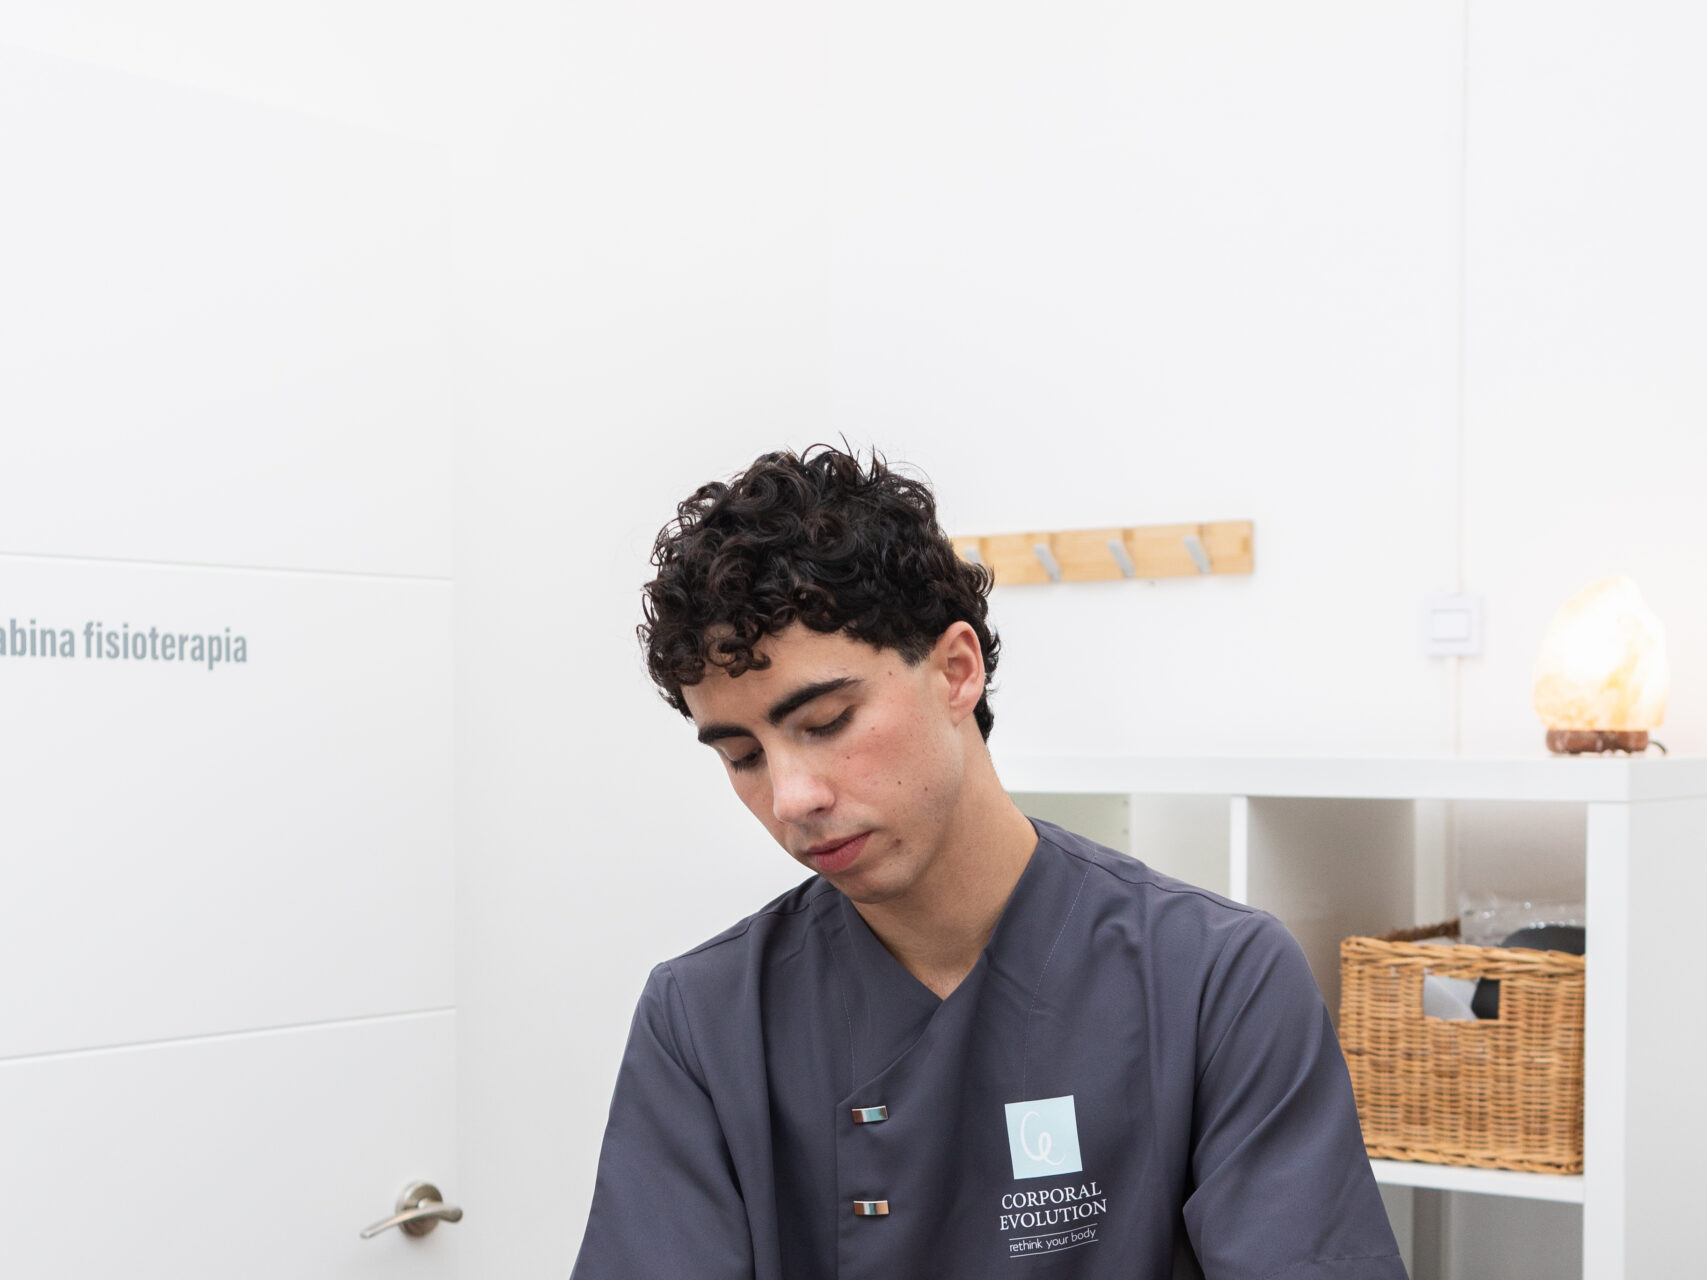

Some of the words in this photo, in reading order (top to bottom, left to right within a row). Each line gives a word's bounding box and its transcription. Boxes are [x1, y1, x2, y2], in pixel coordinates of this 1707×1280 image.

[83, 621, 248, 671] fisioterapia
[1001, 1182, 1102, 1210] CORPORAL
[1000, 1199, 1107, 1230] EVOLUTION
[1009, 1239, 1043, 1252] rethink
[1046, 1234, 1069, 1249] your
[1071, 1228, 1096, 1242] body
